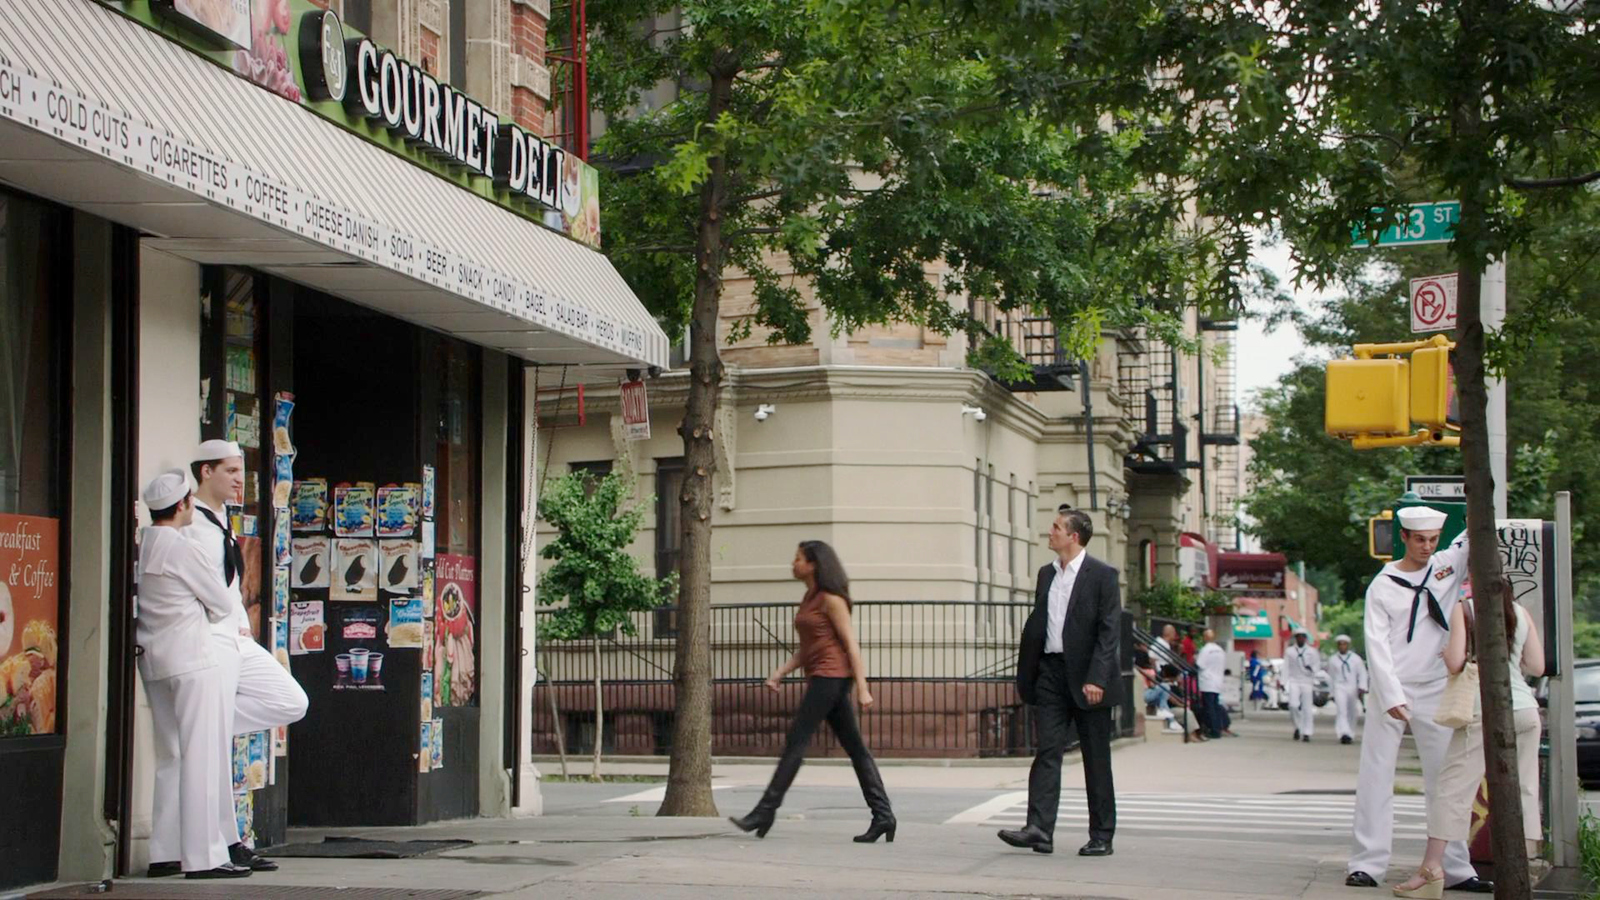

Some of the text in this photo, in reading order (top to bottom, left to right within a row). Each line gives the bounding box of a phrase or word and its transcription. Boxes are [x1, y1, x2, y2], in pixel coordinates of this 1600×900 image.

[358, 38, 564, 211] GOURMET DELI
[47, 90, 87, 131] COLD
[92, 110, 129, 149] CUTS
[150, 135, 228, 190] CIGARETTES
[246, 175, 288, 215] COFFEE
[304, 200, 343, 237] CHEESE
[345, 217, 379, 251] DANISH
[390, 235, 414, 263] SODA
[426, 249, 447, 277] BEER
[458, 262, 483, 291] SNACK
[493, 278, 517, 303] CANDY
[525, 290, 547, 316] BAGEL
[556, 302, 576, 327] SALAD
[576, 309, 589, 333] BAR
[596, 316, 614, 341] HEROS
[622, 327, 642, 352] MUFFINS
[1433, 206, 1453, 223] ST
[1418, 484, 1442, 495] ONE
[9, 559, 54, 599] & Coffee
